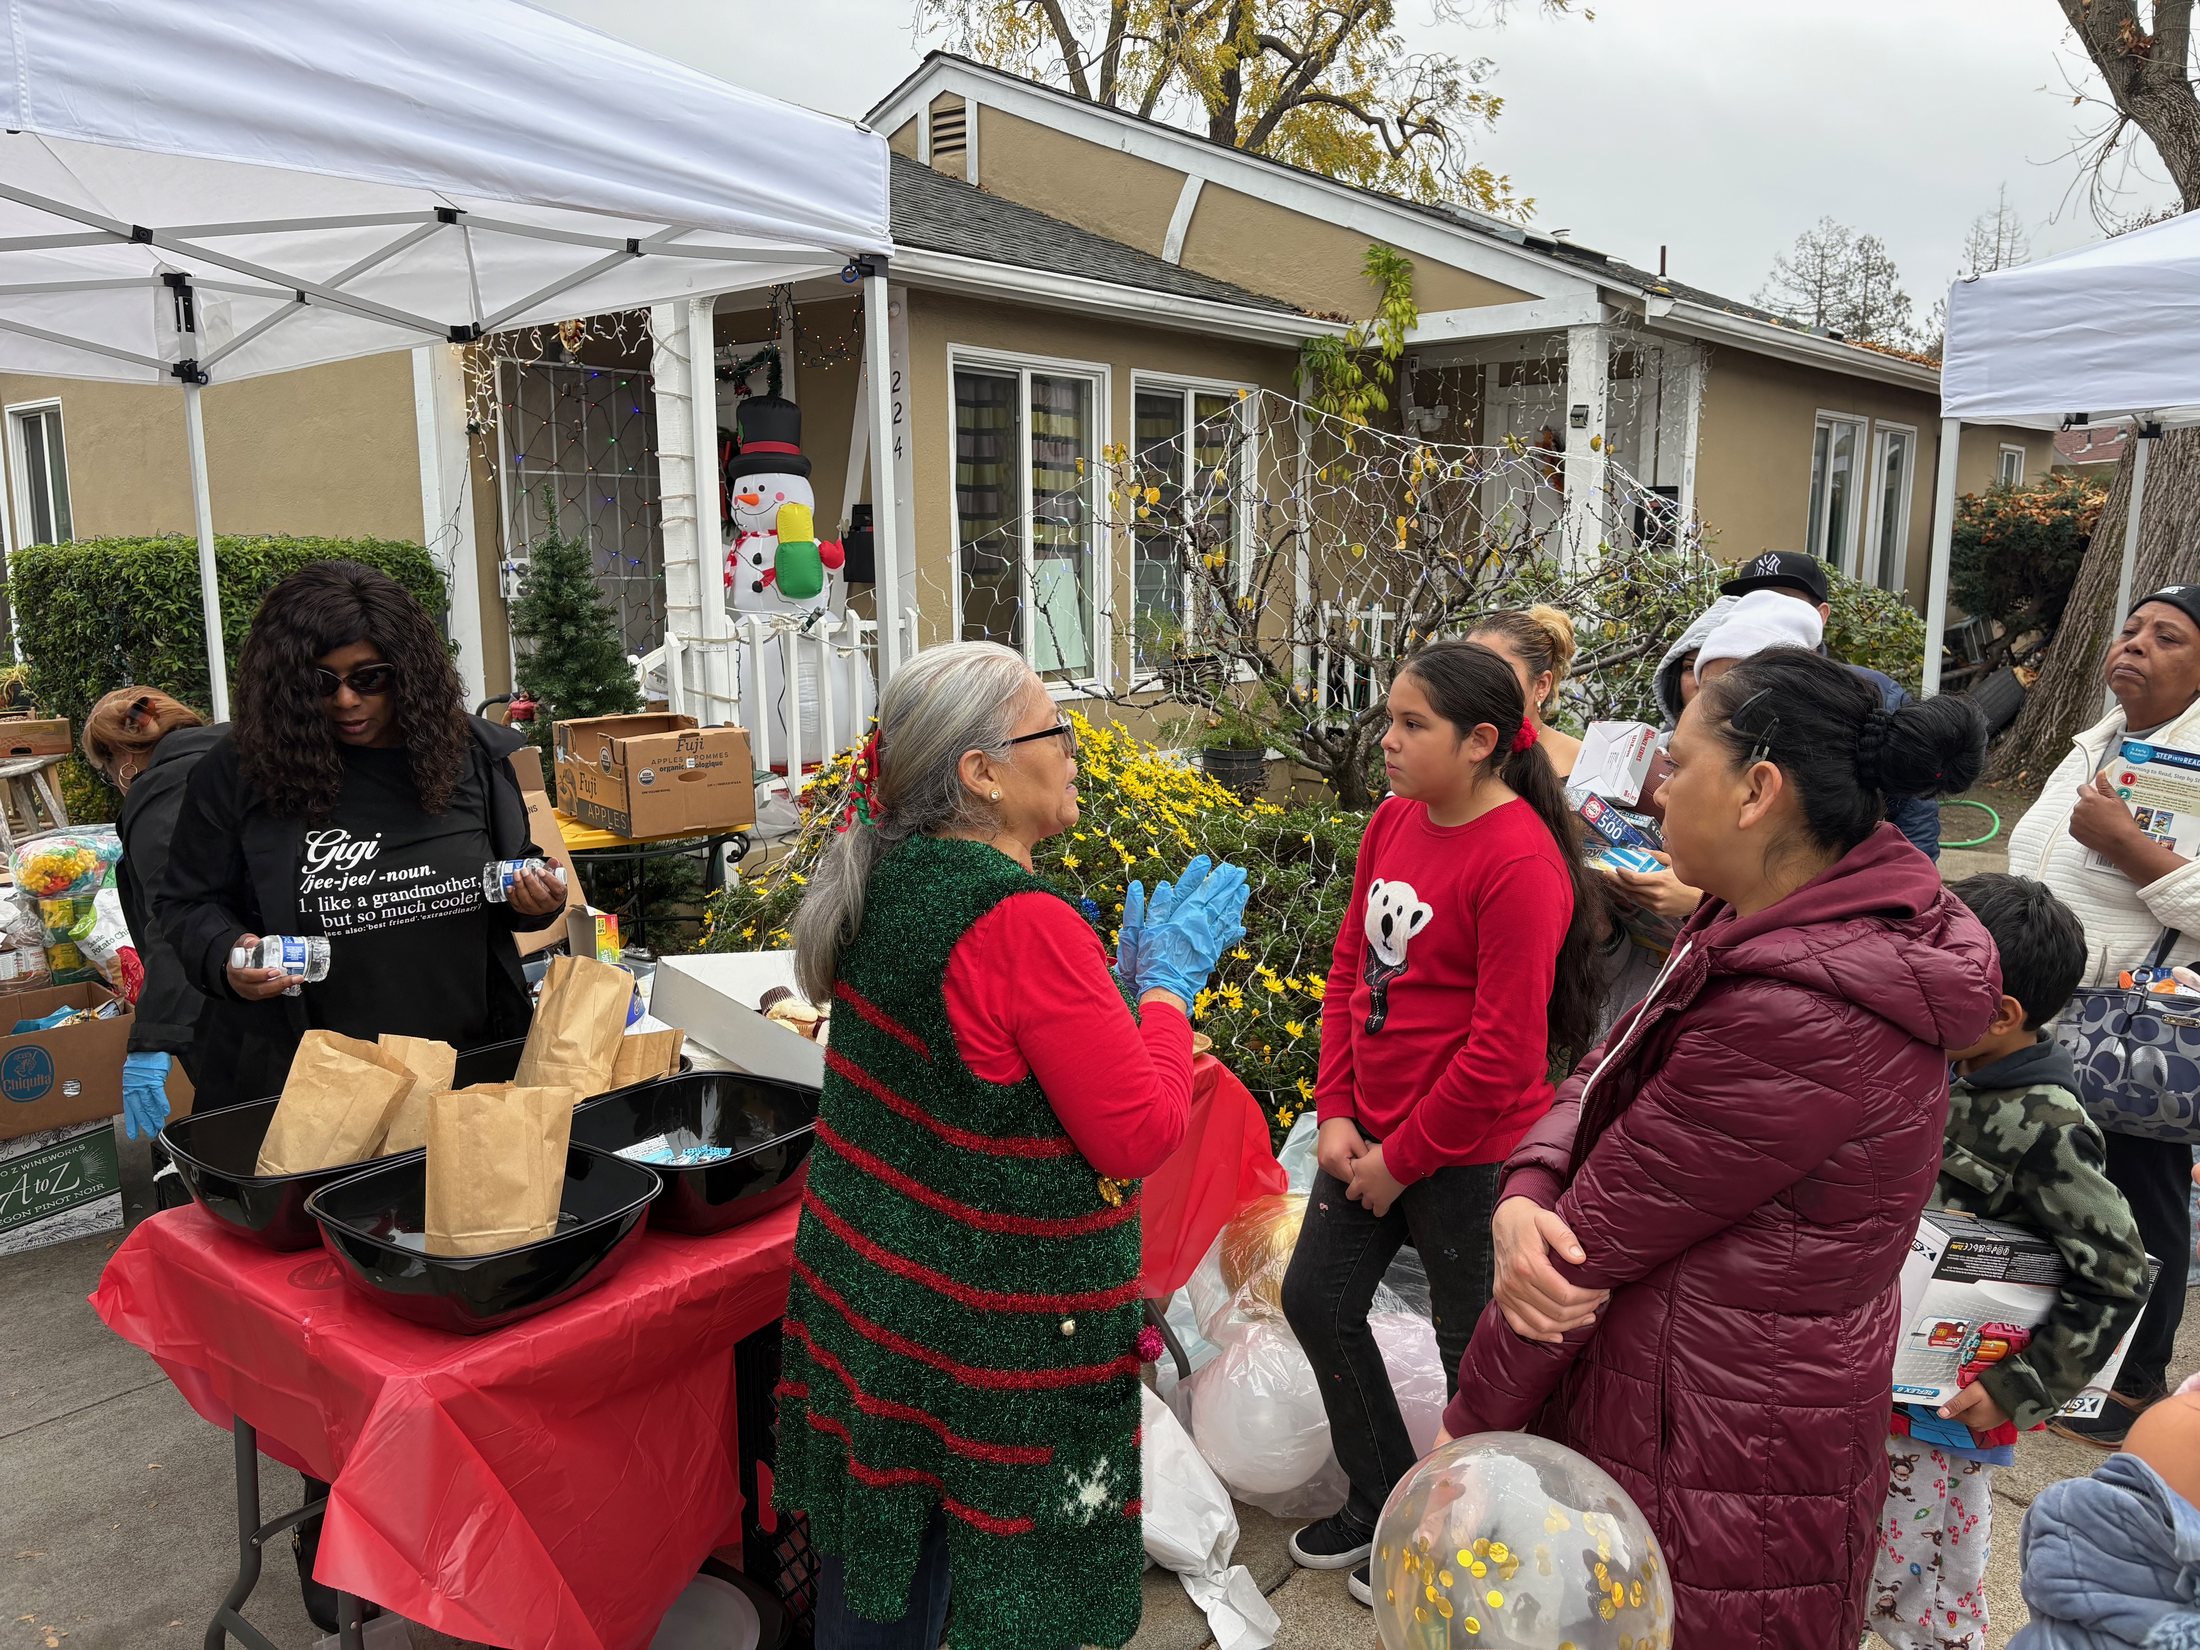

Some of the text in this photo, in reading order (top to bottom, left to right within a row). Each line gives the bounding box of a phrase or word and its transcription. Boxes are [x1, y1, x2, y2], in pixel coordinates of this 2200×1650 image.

[651, 756, 684, 766] APPLES
[694, 751, 729, 762] POMMES
[676, 738, 705, 754] Fuji
[2155, 751, 2173, 763] STEP
[579, 771, 597, 800] Fuji
[2186, 776, 2194, 784] by
[588, 803, 627, 831] APPLES
[1598, 815, 1623, 840] 500
[1604, 808, 1627, 830] PUZZLE
[301, 828, 382, 875] Gigi
[379, 864, 437, 883] -noun.
[298, 876, 482, 913] 1. like a grandmother,
[320, 891, 480, 928] but so much cooler
[91, 938, 115, 956] Potato
[115, 926, 129, 940] Chi
[3, 1074, 52, 1092] Chiquita
[21, 1143, 86, 1171] WINEWORKS
[0, 1161, 80, 1215] A to Z
[34, 1195, 71, 1213] PINOT
[74, 1182, 105, 1199] NOIR
